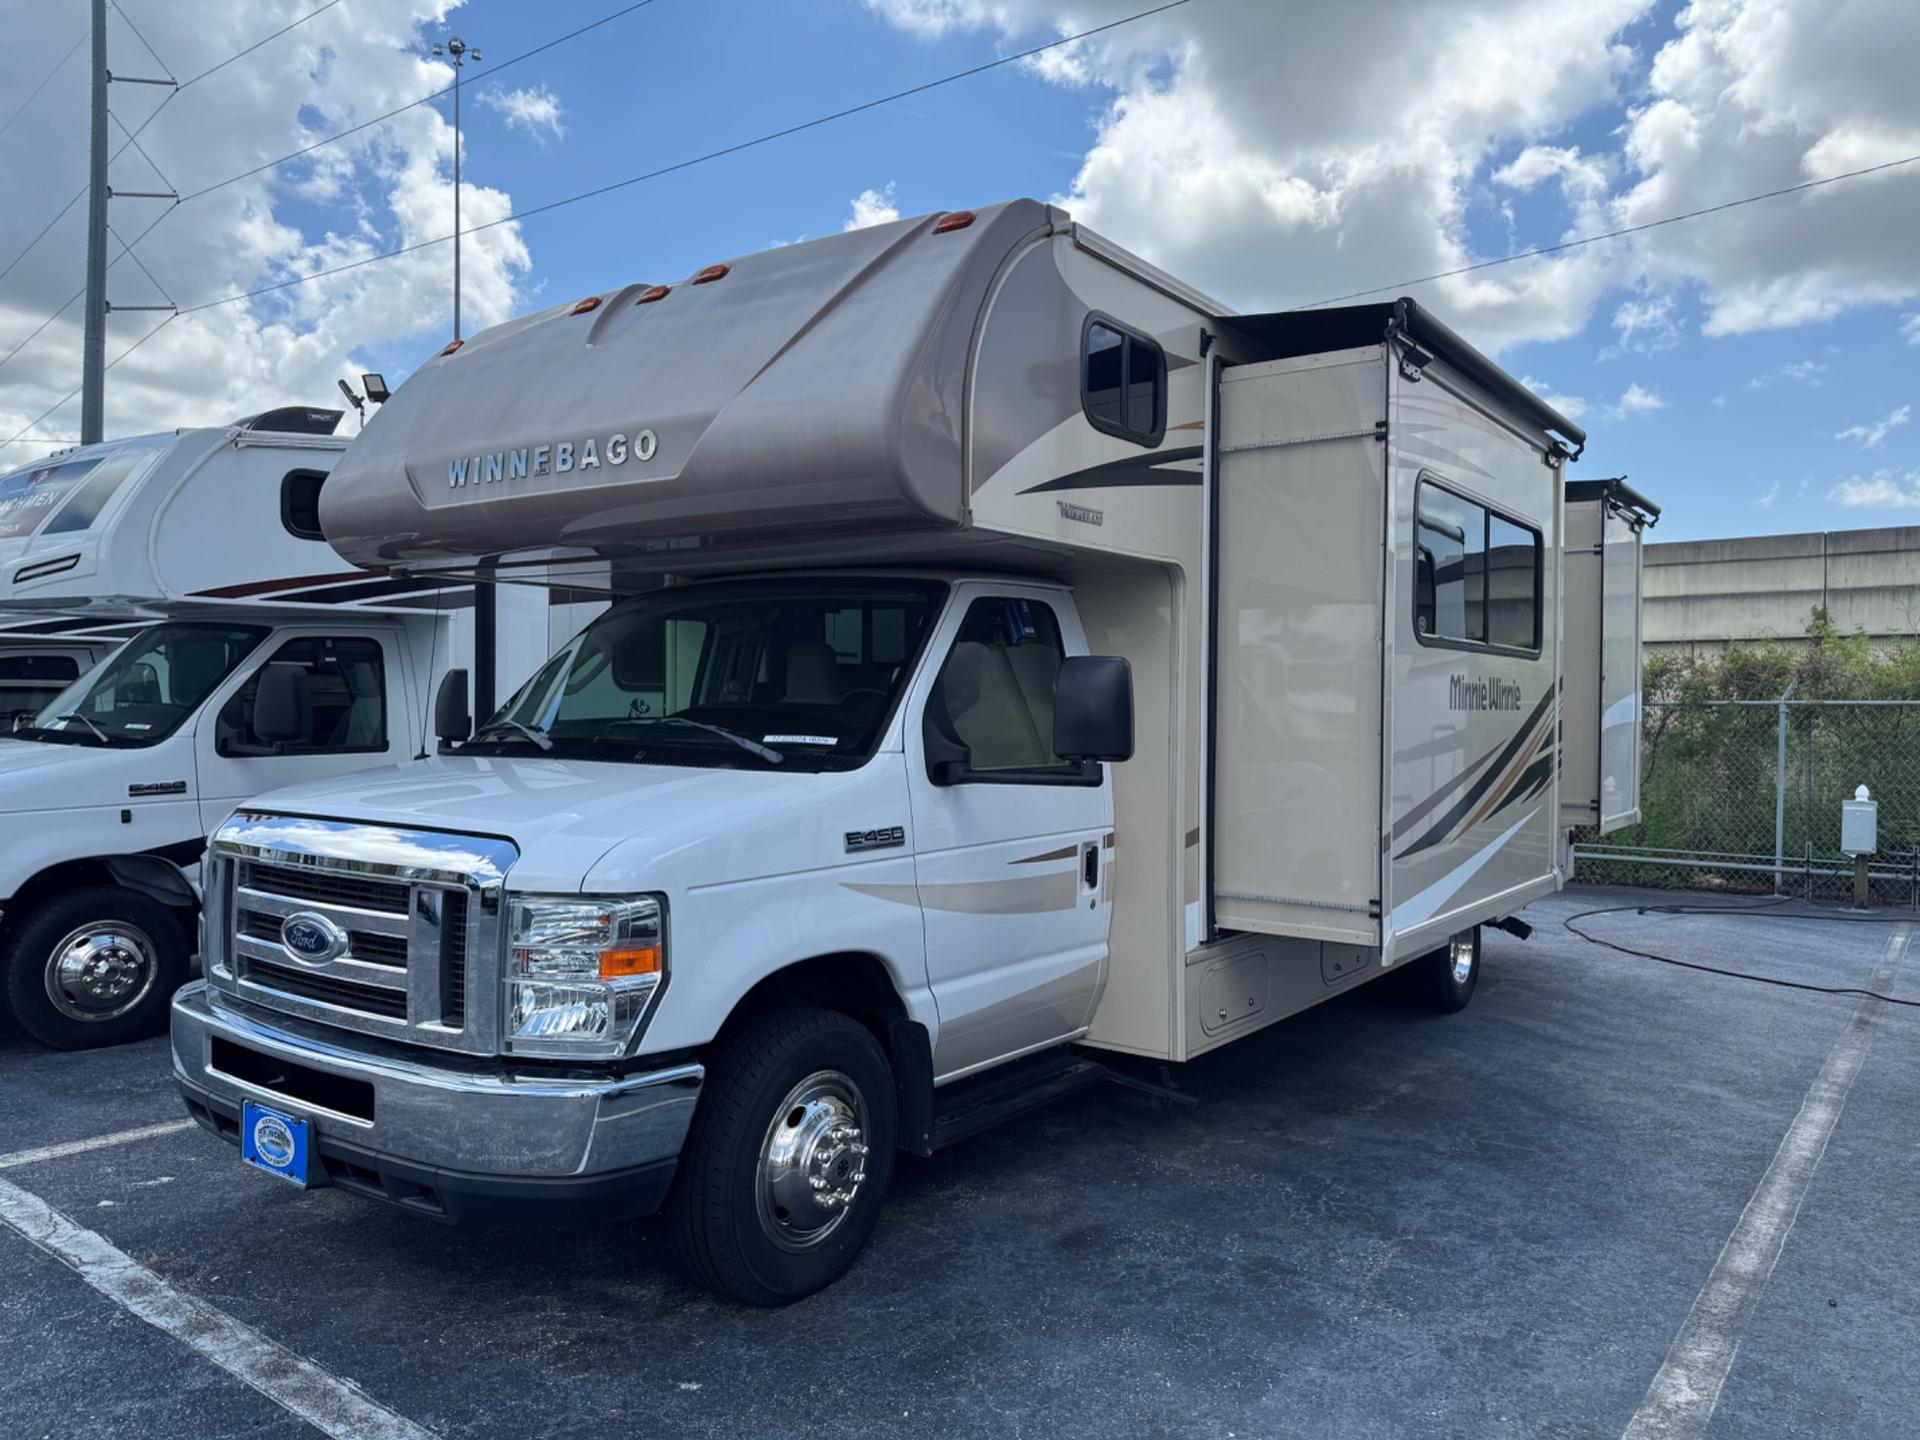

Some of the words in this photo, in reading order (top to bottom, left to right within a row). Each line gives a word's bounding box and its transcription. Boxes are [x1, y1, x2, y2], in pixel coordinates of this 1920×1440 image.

[448, 429, 658, 488] WINNEBAGO
[1449, 674, 1487, 711] Minnie
[1488, 676, 1522, 711] Winnie
[290, 925, 319, 949] Ford
